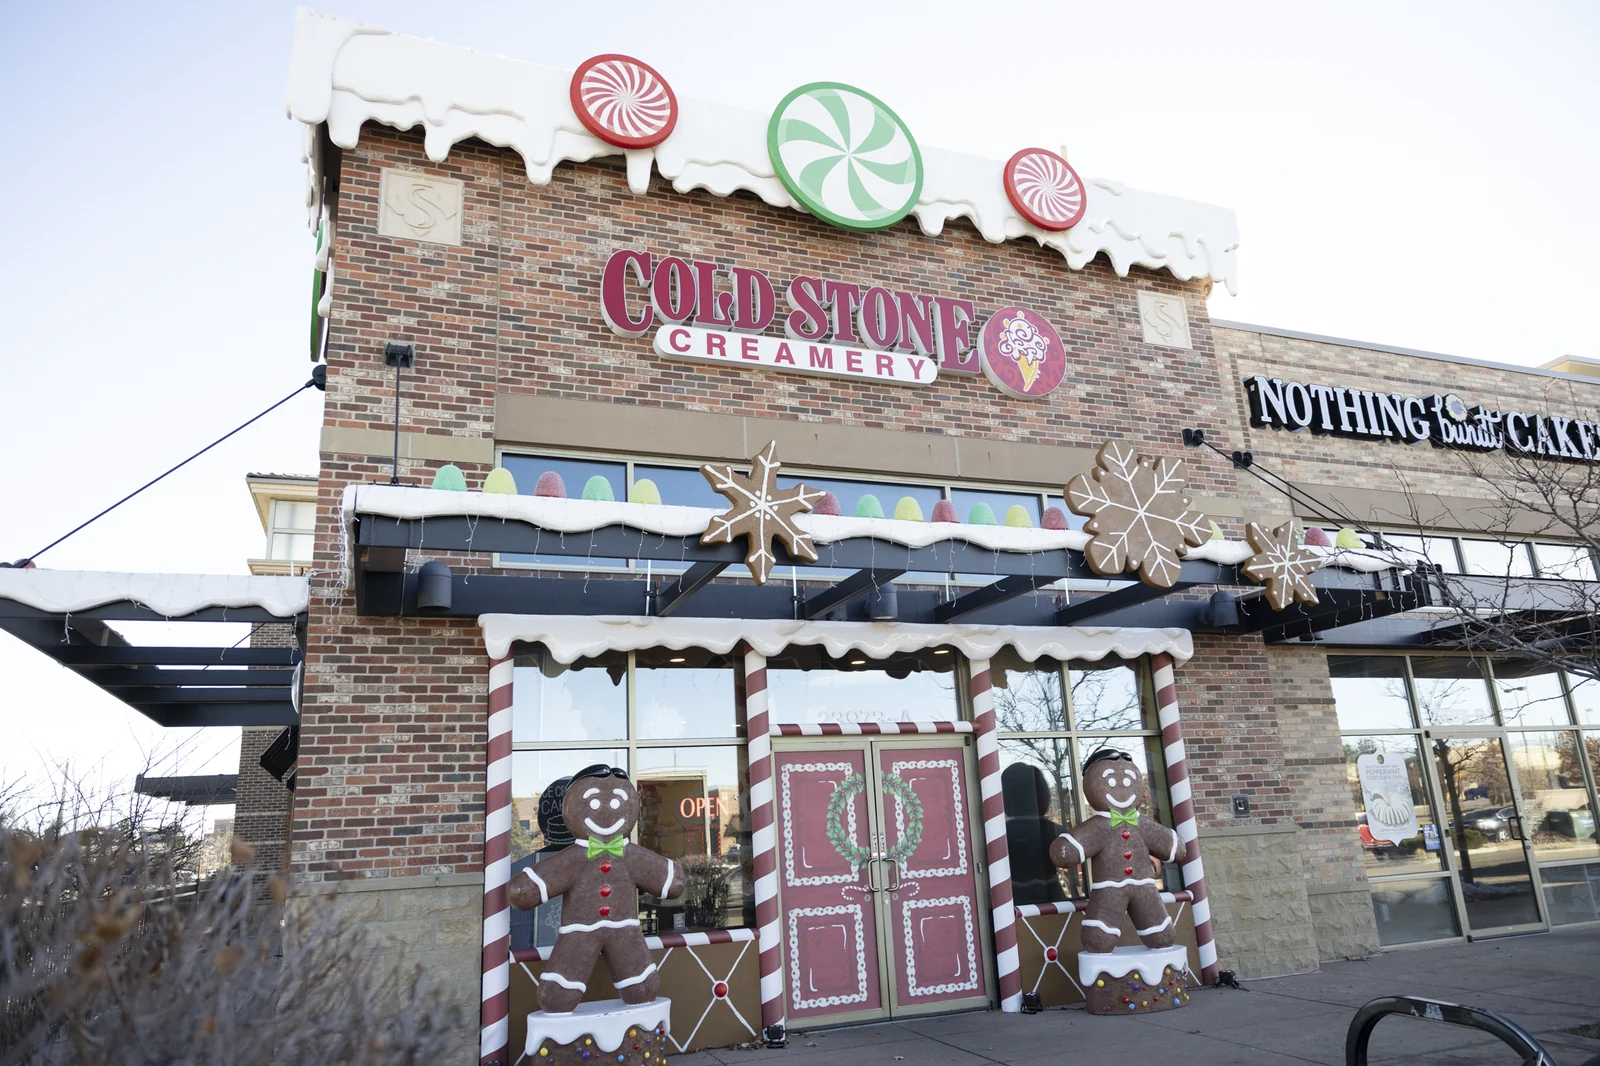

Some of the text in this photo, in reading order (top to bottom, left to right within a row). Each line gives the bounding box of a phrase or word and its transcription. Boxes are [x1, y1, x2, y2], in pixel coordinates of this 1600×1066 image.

[601, 249, 981, 375] COLD STONE
[668, 328, 926, 380] CREAMERY
[1252, 375, 1430, 442] NOTHING
[1506, 410, 1600, 462] CAKE
[1365, 768, 1400, 776] PEPPERMINT
[680, 796, 729, 818] OPEN
